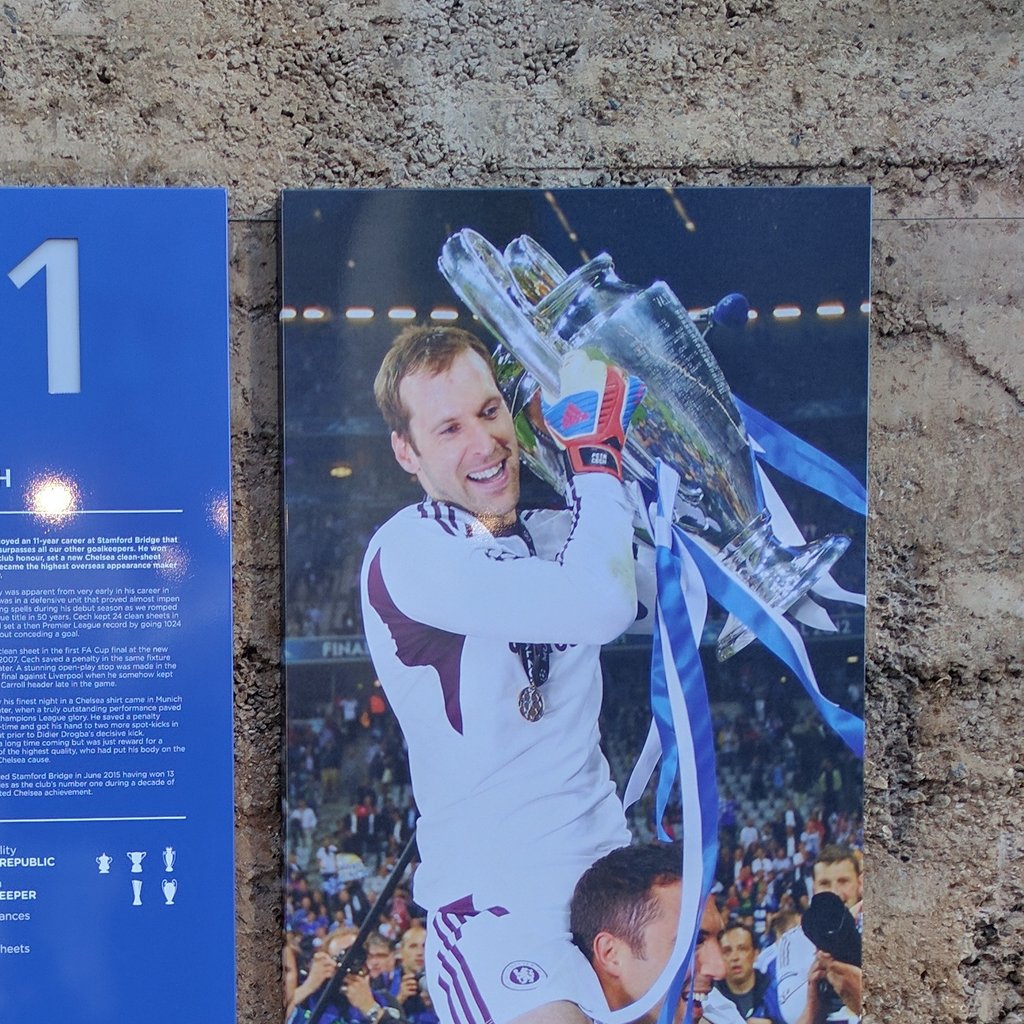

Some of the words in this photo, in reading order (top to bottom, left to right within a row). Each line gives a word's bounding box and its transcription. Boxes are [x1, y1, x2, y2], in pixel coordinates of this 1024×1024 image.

[8, 238, 80, 394] 1
[33, 537, 59, 546] 11-year
[135, 536, 160, 545] Bridge
[87, 544, 136, 554] goalkeepers.
[16, 554, 44, 563] honour,
[41, 562, 69, 571] highest
[48, 772, 73, 781] Bridge
[122, 771, 147, 780] having
[105, 779, 129, 788] during
[0, 857, 56, 868] REPUBLIC
